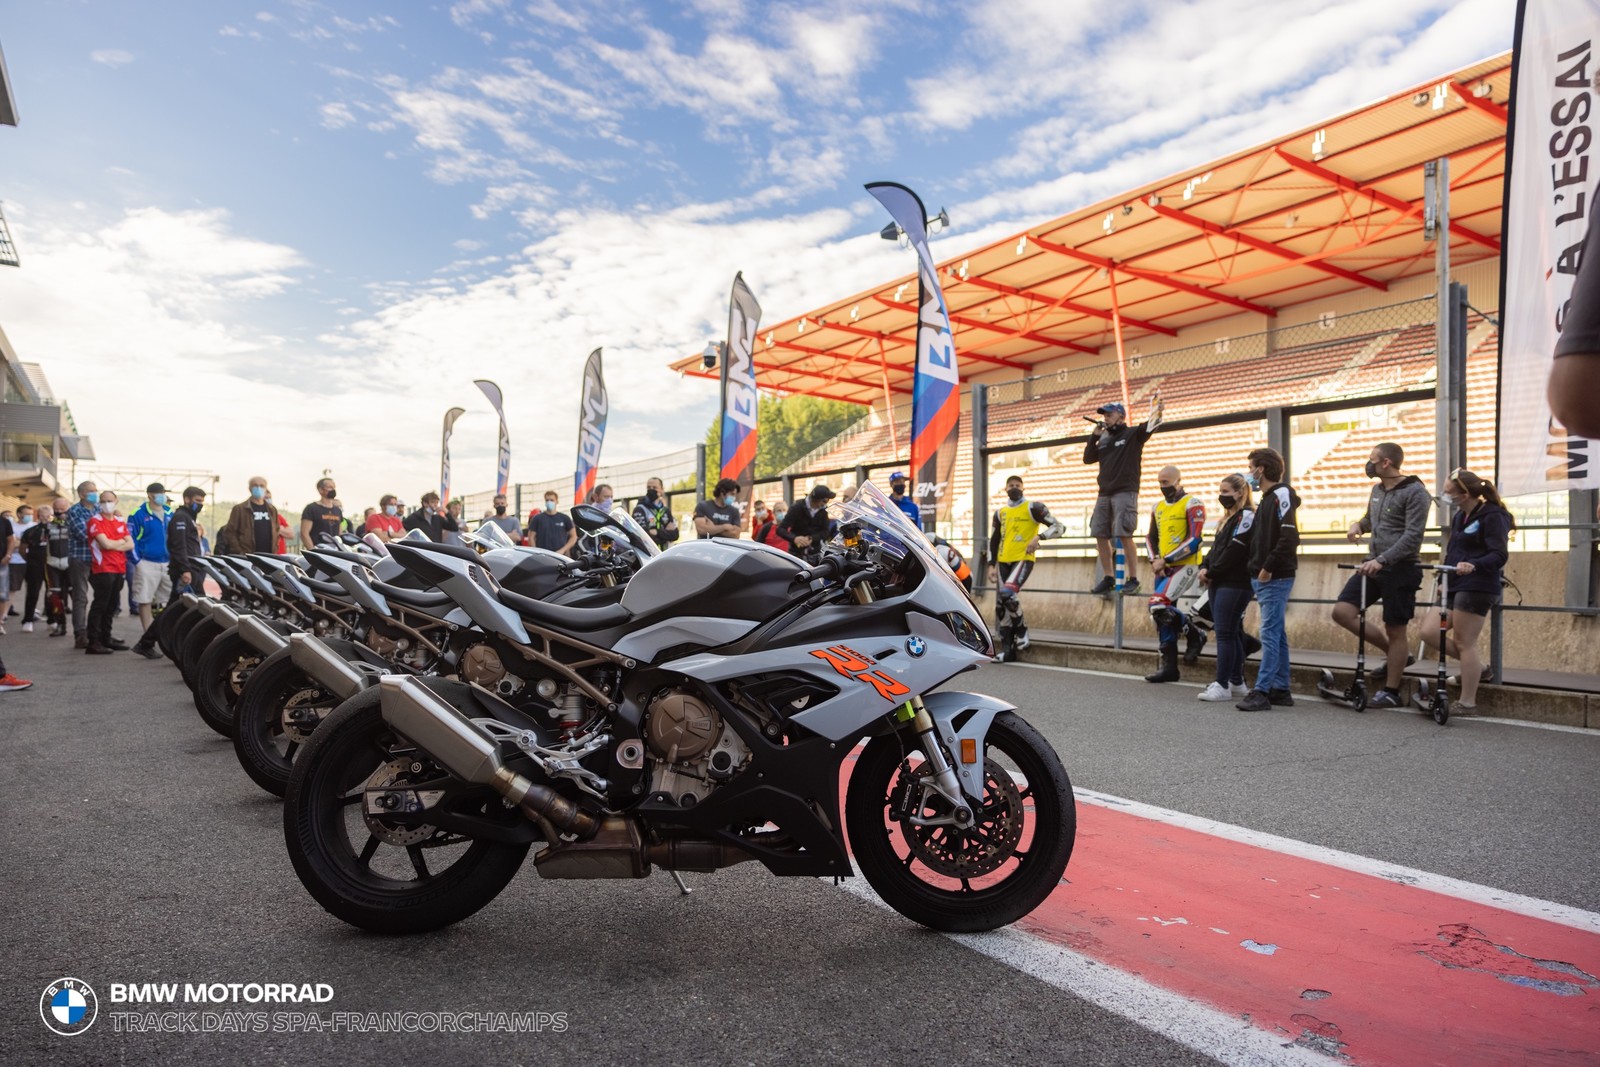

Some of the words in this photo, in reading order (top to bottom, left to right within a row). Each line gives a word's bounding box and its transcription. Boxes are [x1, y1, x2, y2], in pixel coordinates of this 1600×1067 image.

[1549, 39, 1592, 228] L'ESSAI
[912, 481, 948, 497] BMC
[808, 646, 911, 704] RR
